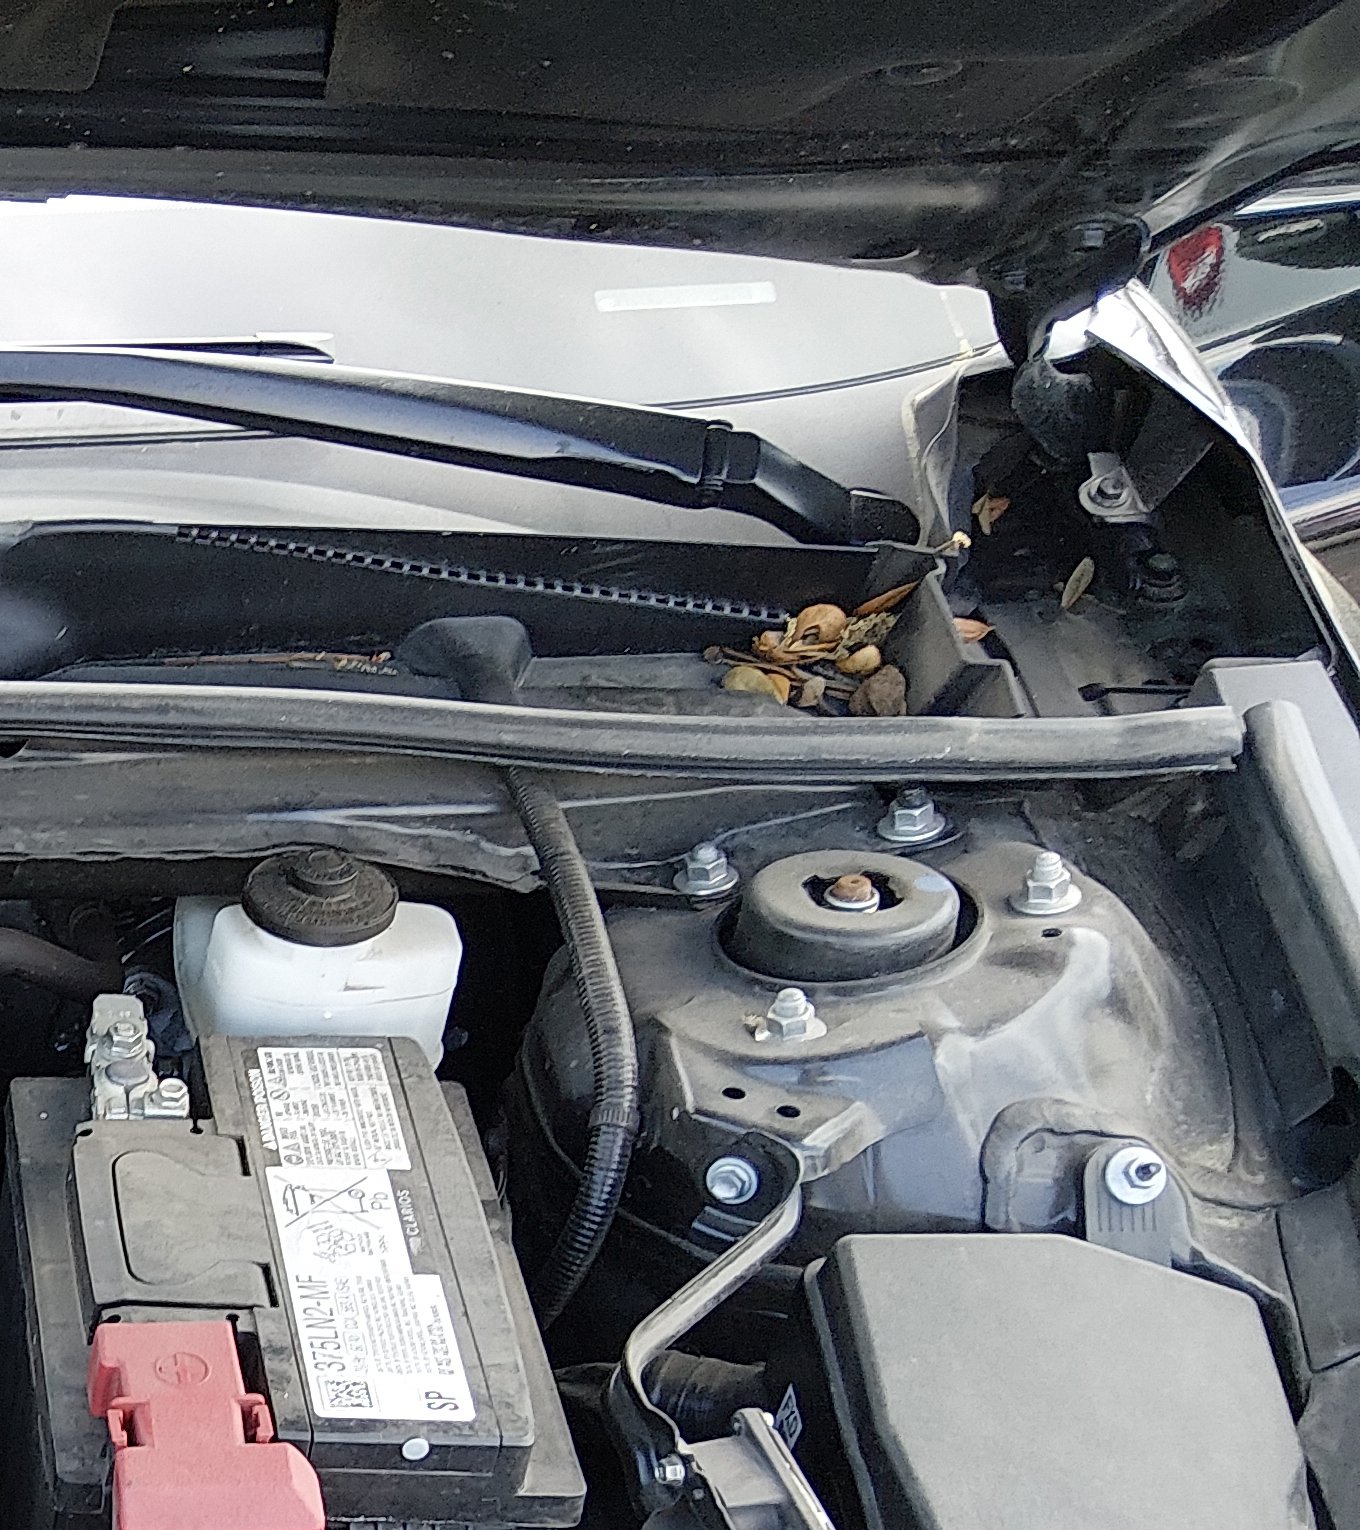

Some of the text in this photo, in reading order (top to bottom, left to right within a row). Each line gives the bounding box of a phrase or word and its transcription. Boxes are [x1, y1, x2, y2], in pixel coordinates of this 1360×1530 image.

[368, 1190, 392, 1212] Pb
[397, 1188, 419, 1237] CLARIOS
[296, 1273, 345, 1373] 375LN2-MF
[425, 1390, 460, 1412] SP
